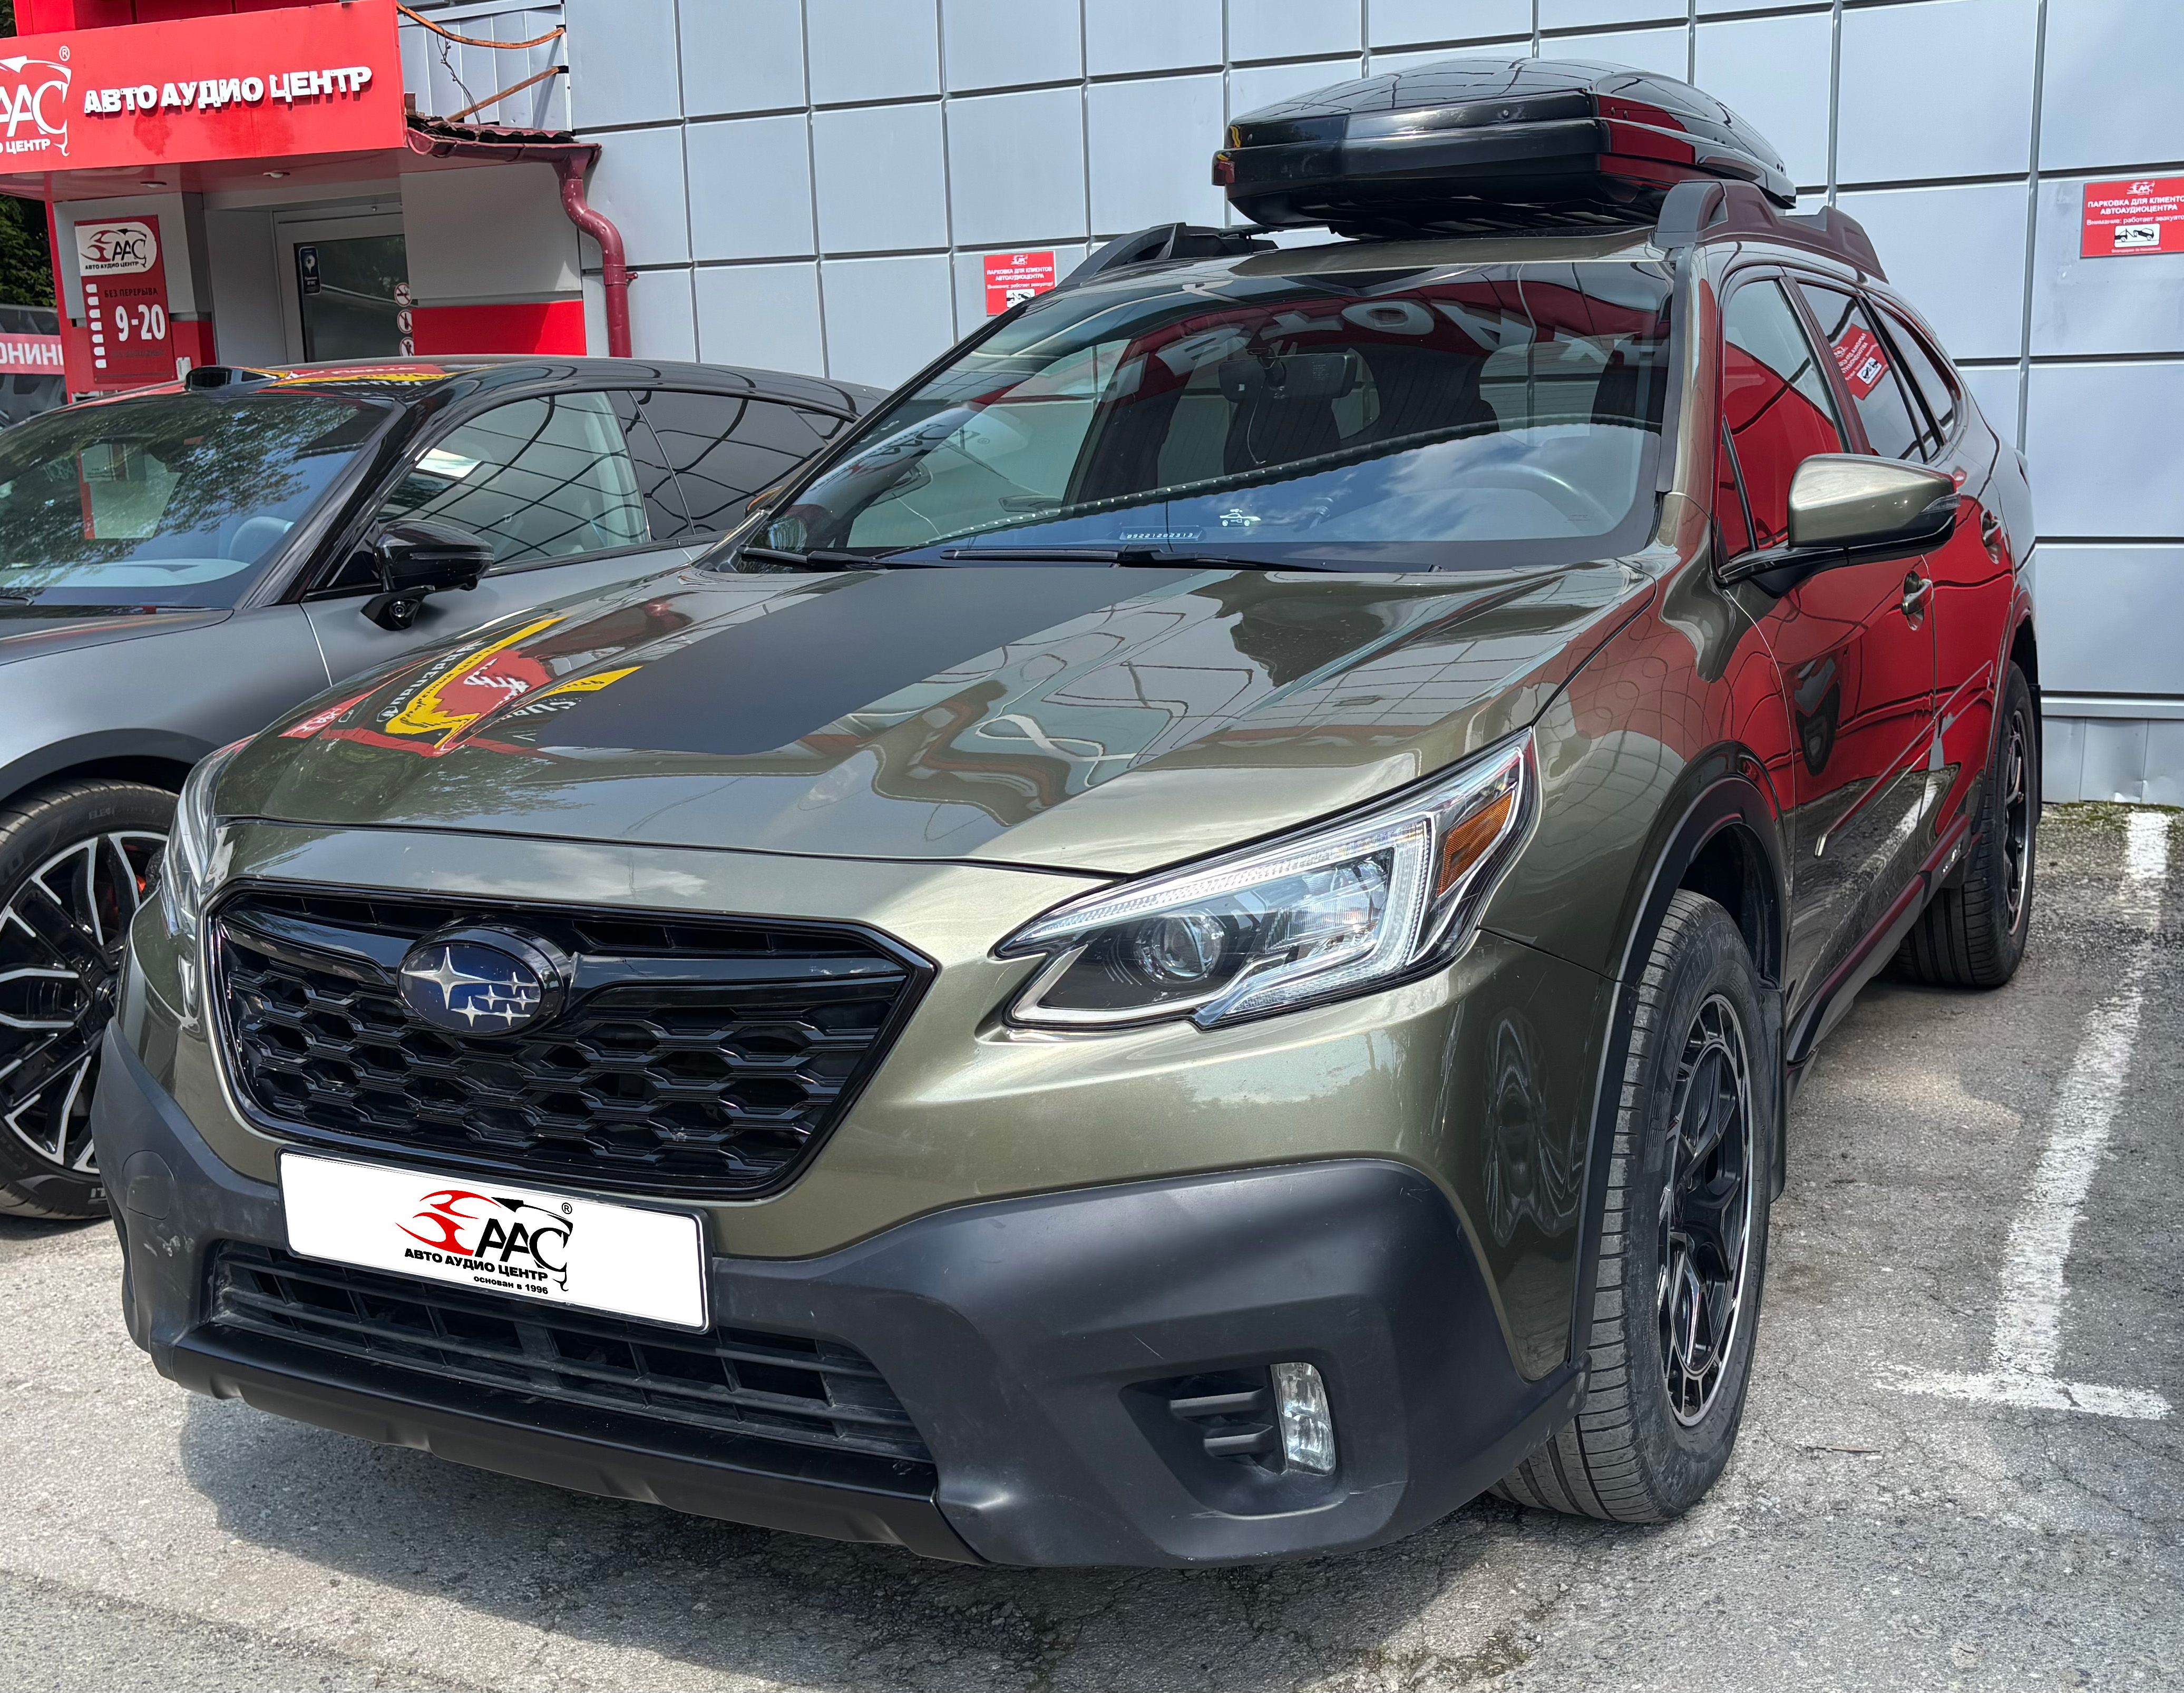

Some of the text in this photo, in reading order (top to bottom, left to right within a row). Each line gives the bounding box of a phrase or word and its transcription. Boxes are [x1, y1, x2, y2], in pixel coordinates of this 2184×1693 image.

[84, 66, 373, 114] АВТО АУДИО ЦЕНТР
[5, 138, 51, 154] ЦЕНТР
[2088, 195, 2184, 208] ПАРКОВКА ДЛЯ КЛИЕНТО
[2100, 204, 2178, 216] АВТОАУДИОЦЕНТРА
[2154, 214, 2184, 222] эвакуато
[104, 287, 158, 298] БЕЗ ПЕРЕРЫВА
[115, 304, 165, 341] 9-20
